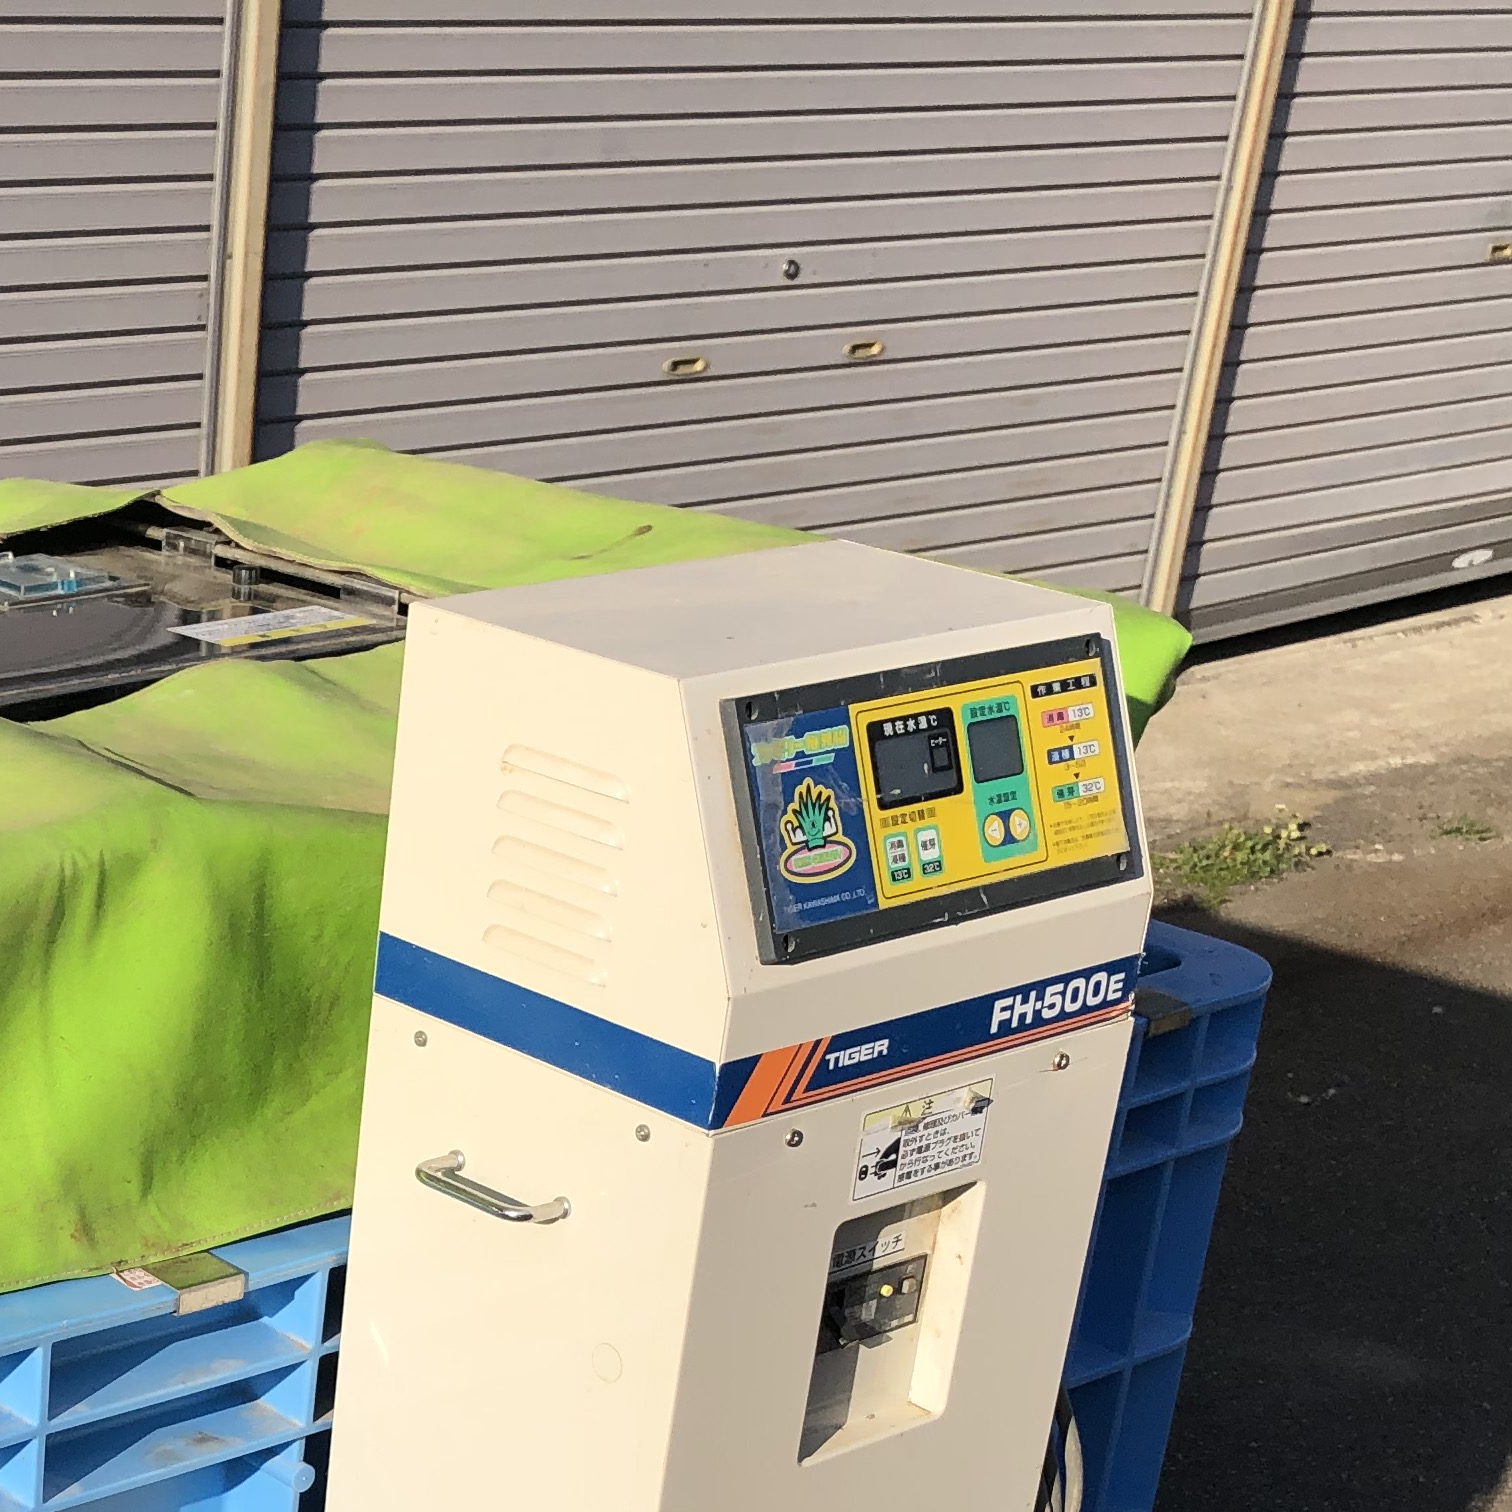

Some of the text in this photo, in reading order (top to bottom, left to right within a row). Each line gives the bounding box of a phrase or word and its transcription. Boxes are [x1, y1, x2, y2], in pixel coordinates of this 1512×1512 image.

[825, 1038, 889, 1070] TIGER
[832, 1233, 903, 1268] 電源スイッチ
